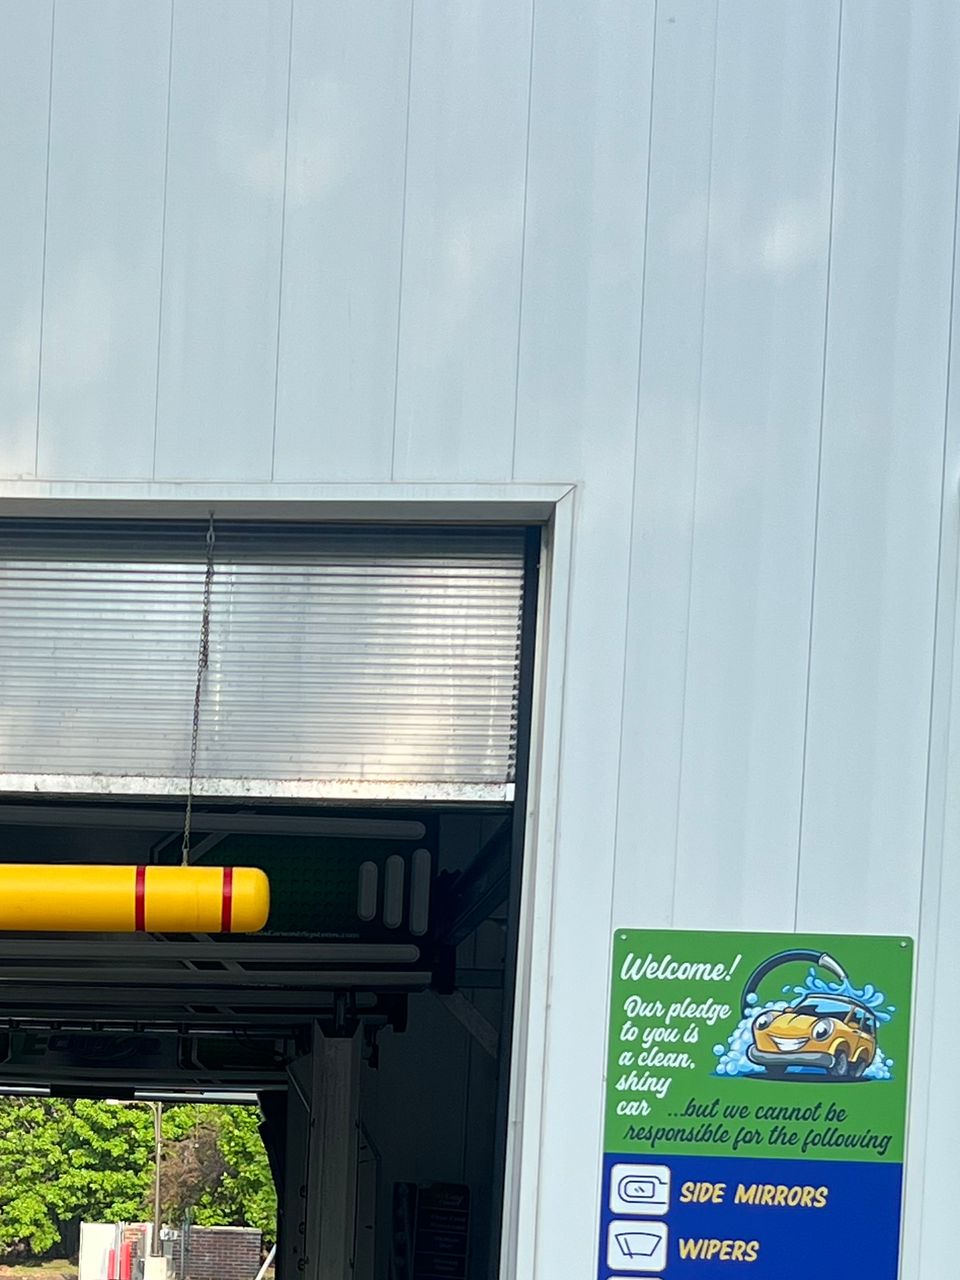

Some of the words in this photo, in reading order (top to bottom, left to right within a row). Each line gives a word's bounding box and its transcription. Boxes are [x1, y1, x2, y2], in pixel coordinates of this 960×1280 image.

[620, 953, 741, 981] Welcome!
[624, 996, 662, 1017] Our
[665, 998, 731, 1024] pledge
[620, 1023, 638, 1041] to
[643, 1028, 679, 1048] you
[683, 1024, 698, 1042] is
[618, 1053, 633, 1065] a
[616, 1072, 671, 1098] shiny
[616, 1101, 650, 1115] car
[723, 1104, 749, 1119] we
[754, 1102, 820, 1121] cannot
[824, 1102, 847, 1122] be
[624, 1124, 729, 1148] responsible
[733, 1124, 762, 1150] for
[768, 1124, 799, 1146] the
[801, 1129, 892, 1155] following
[680, 1182, 725, 1204] SIDE
[735, 1185, 828, 1207] MIRRORS
[679, 1238, 759, 1262] WIPERS
